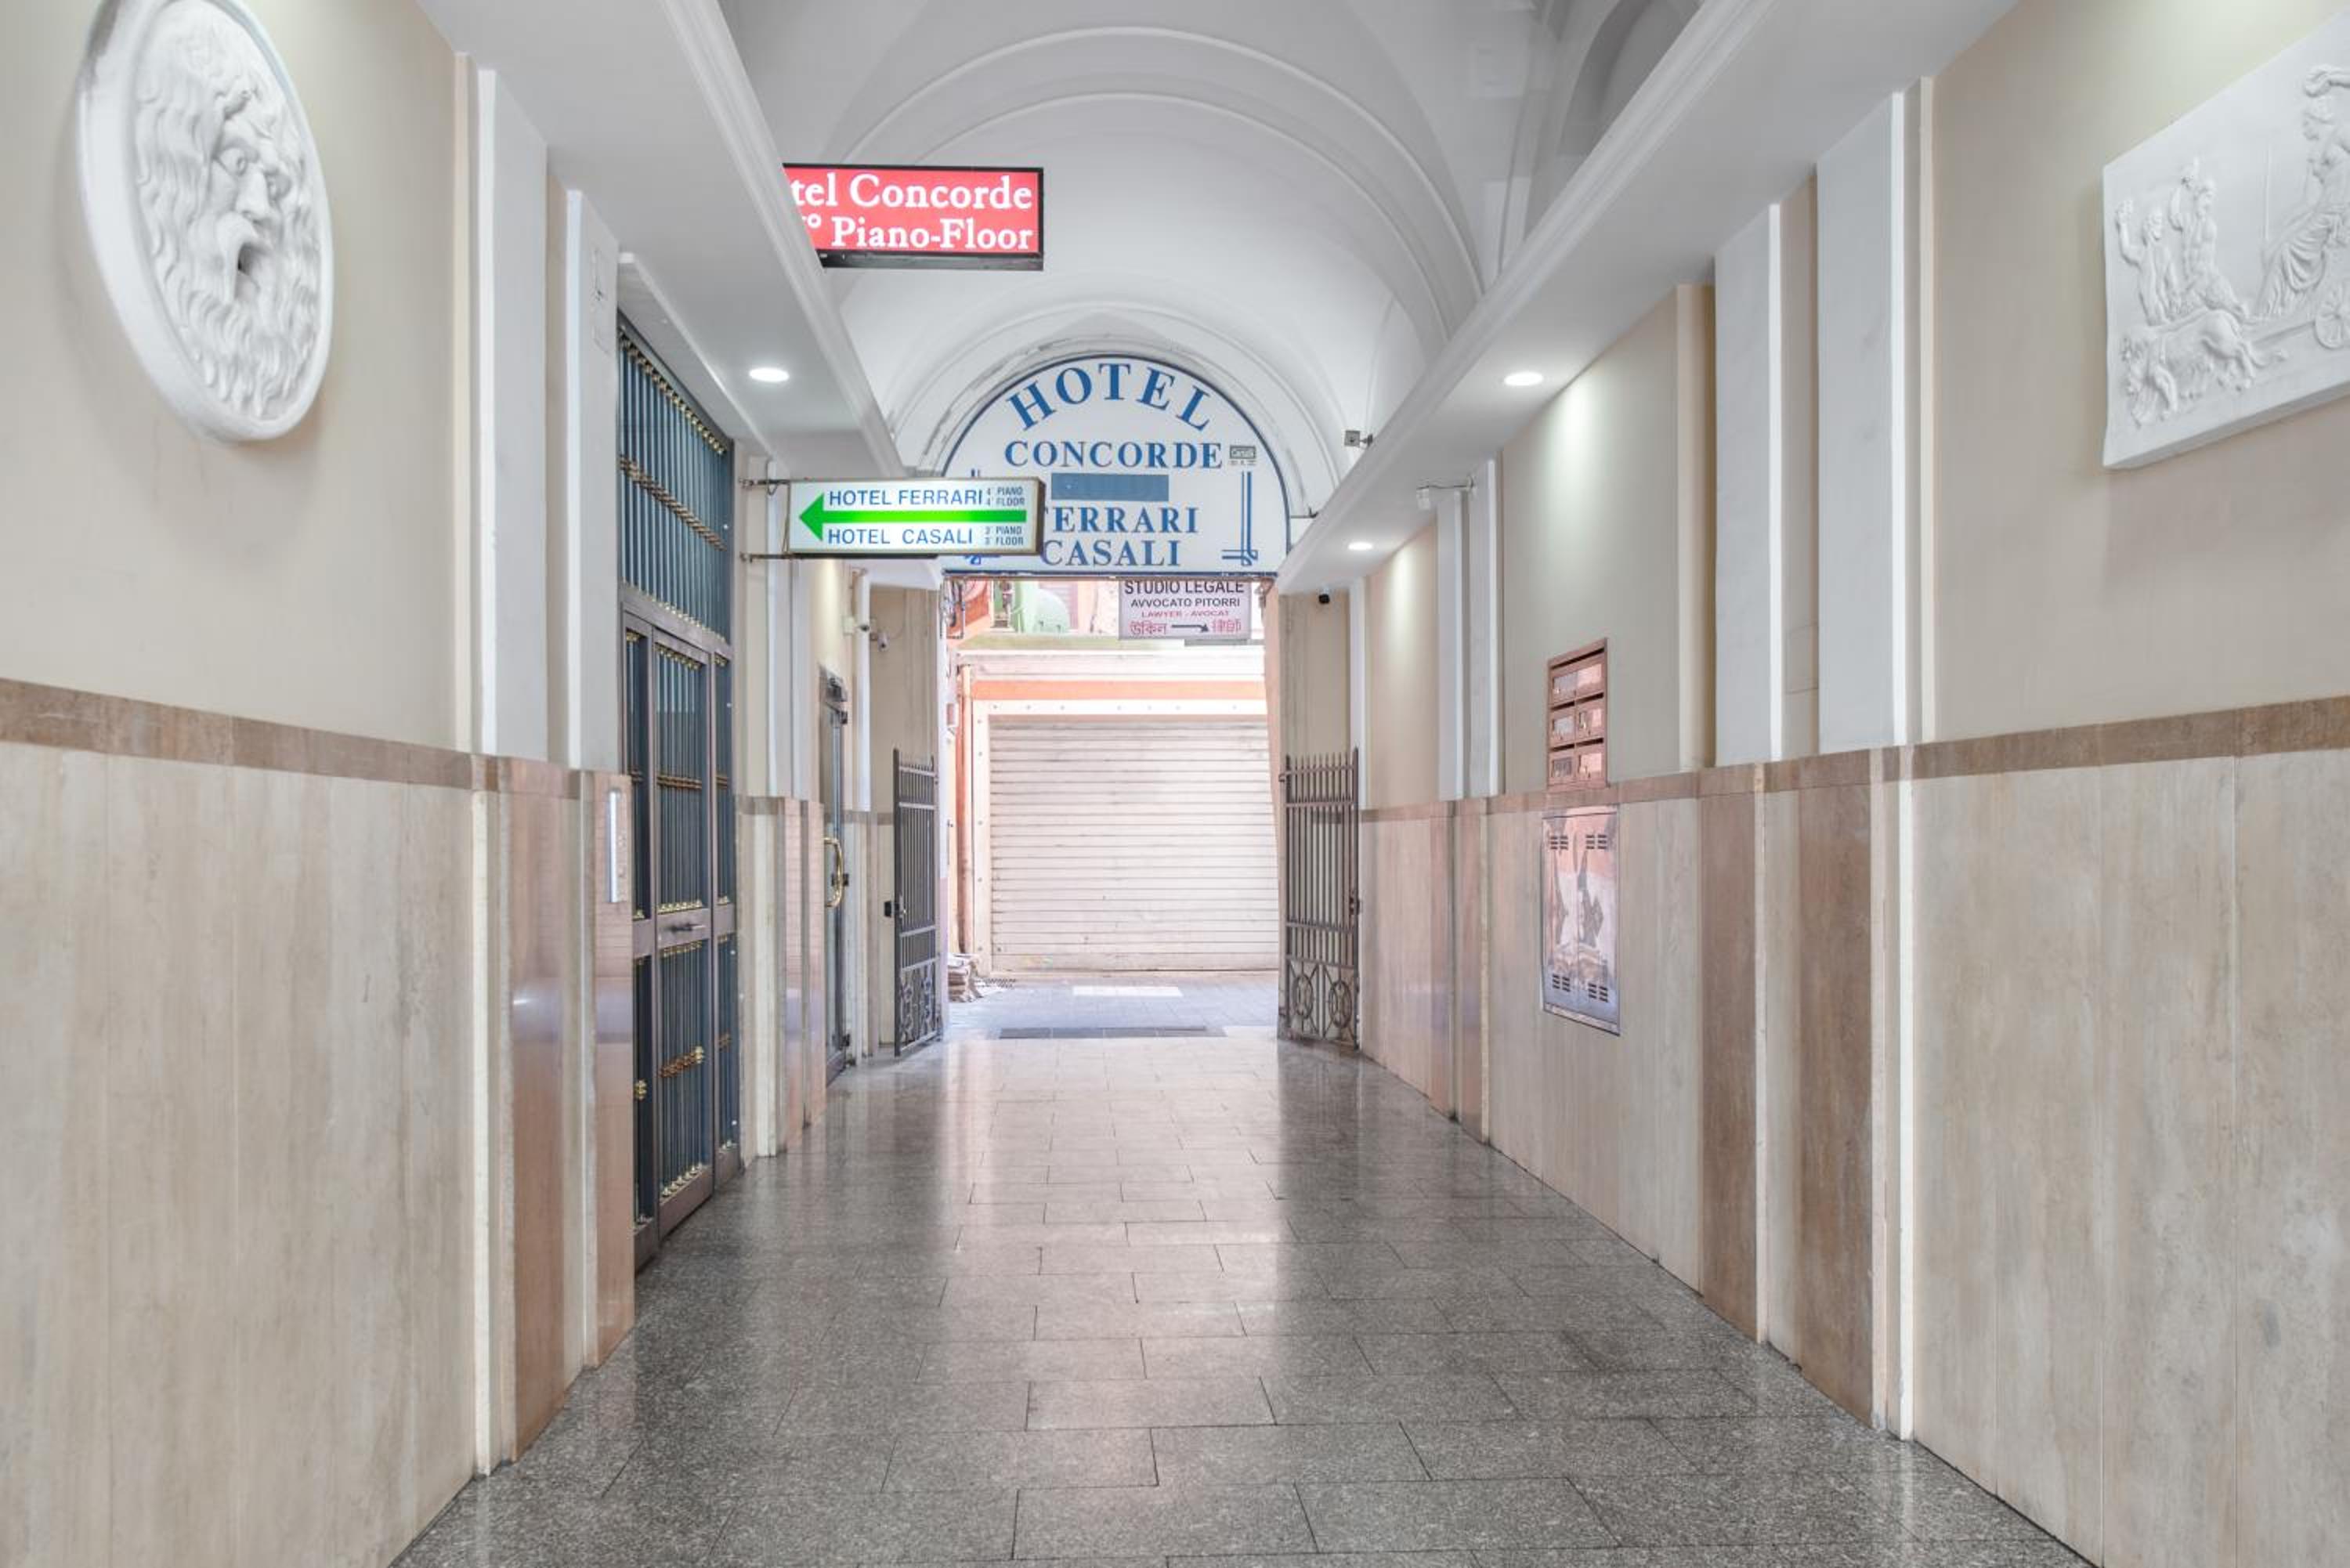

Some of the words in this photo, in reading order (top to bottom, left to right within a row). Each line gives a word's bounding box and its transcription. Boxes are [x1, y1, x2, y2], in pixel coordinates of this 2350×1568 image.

[849, 173, 1032, 209] Concorde
[831, 216, 1033, 250] Piano-Floor
[1006, 363, 1213, 432] HOTEL
[1004, 440, 1223, 469] CONCORDE
[829, 490, 891, 506] HOTEL
[898, 490, 982, 505] FERRARI
[997, 486, 1023, 496] PIANO
[996, 497, 1025, 507] FLOOR
[1043, 507, 1198, 533] ERRARI
[828, 529, 891, 545] HOTEL
[902, 528, 973, 544] CASALI
[996, 526, 1022, 535] PIANO
[996, 537, 1024, 546] FLOOR
[1040, 540, 1180, 566] CASALI
[1125, 580, 1180, 594] STUDIO
[1185, 580, 1244, 594] LEGALE
[1130, 598, 1192, 608] AVVOCATO
[1195, 598, 1240, 607] PITORRI
